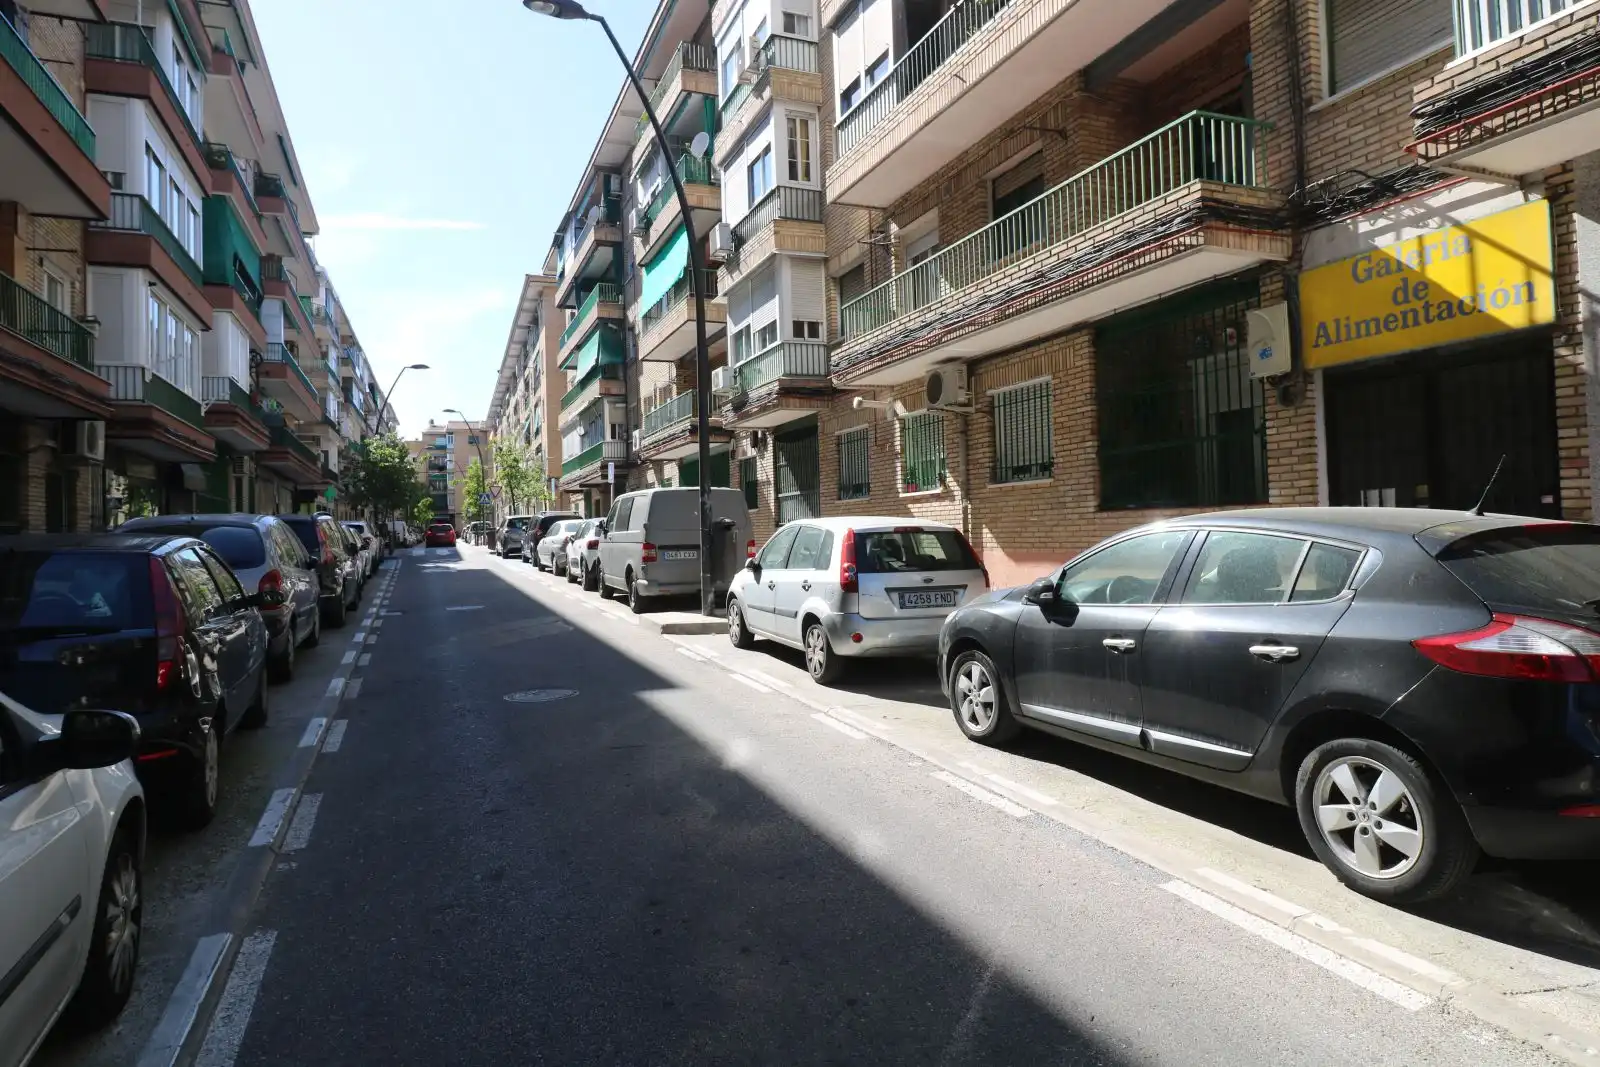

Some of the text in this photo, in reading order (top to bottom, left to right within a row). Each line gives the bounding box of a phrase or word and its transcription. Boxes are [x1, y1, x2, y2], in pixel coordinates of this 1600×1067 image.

[1391, 277, 1430, 306] de
[1311, 278, 1538, 348] Alimentación
[906, 592, 952, 605] 4258 FND
